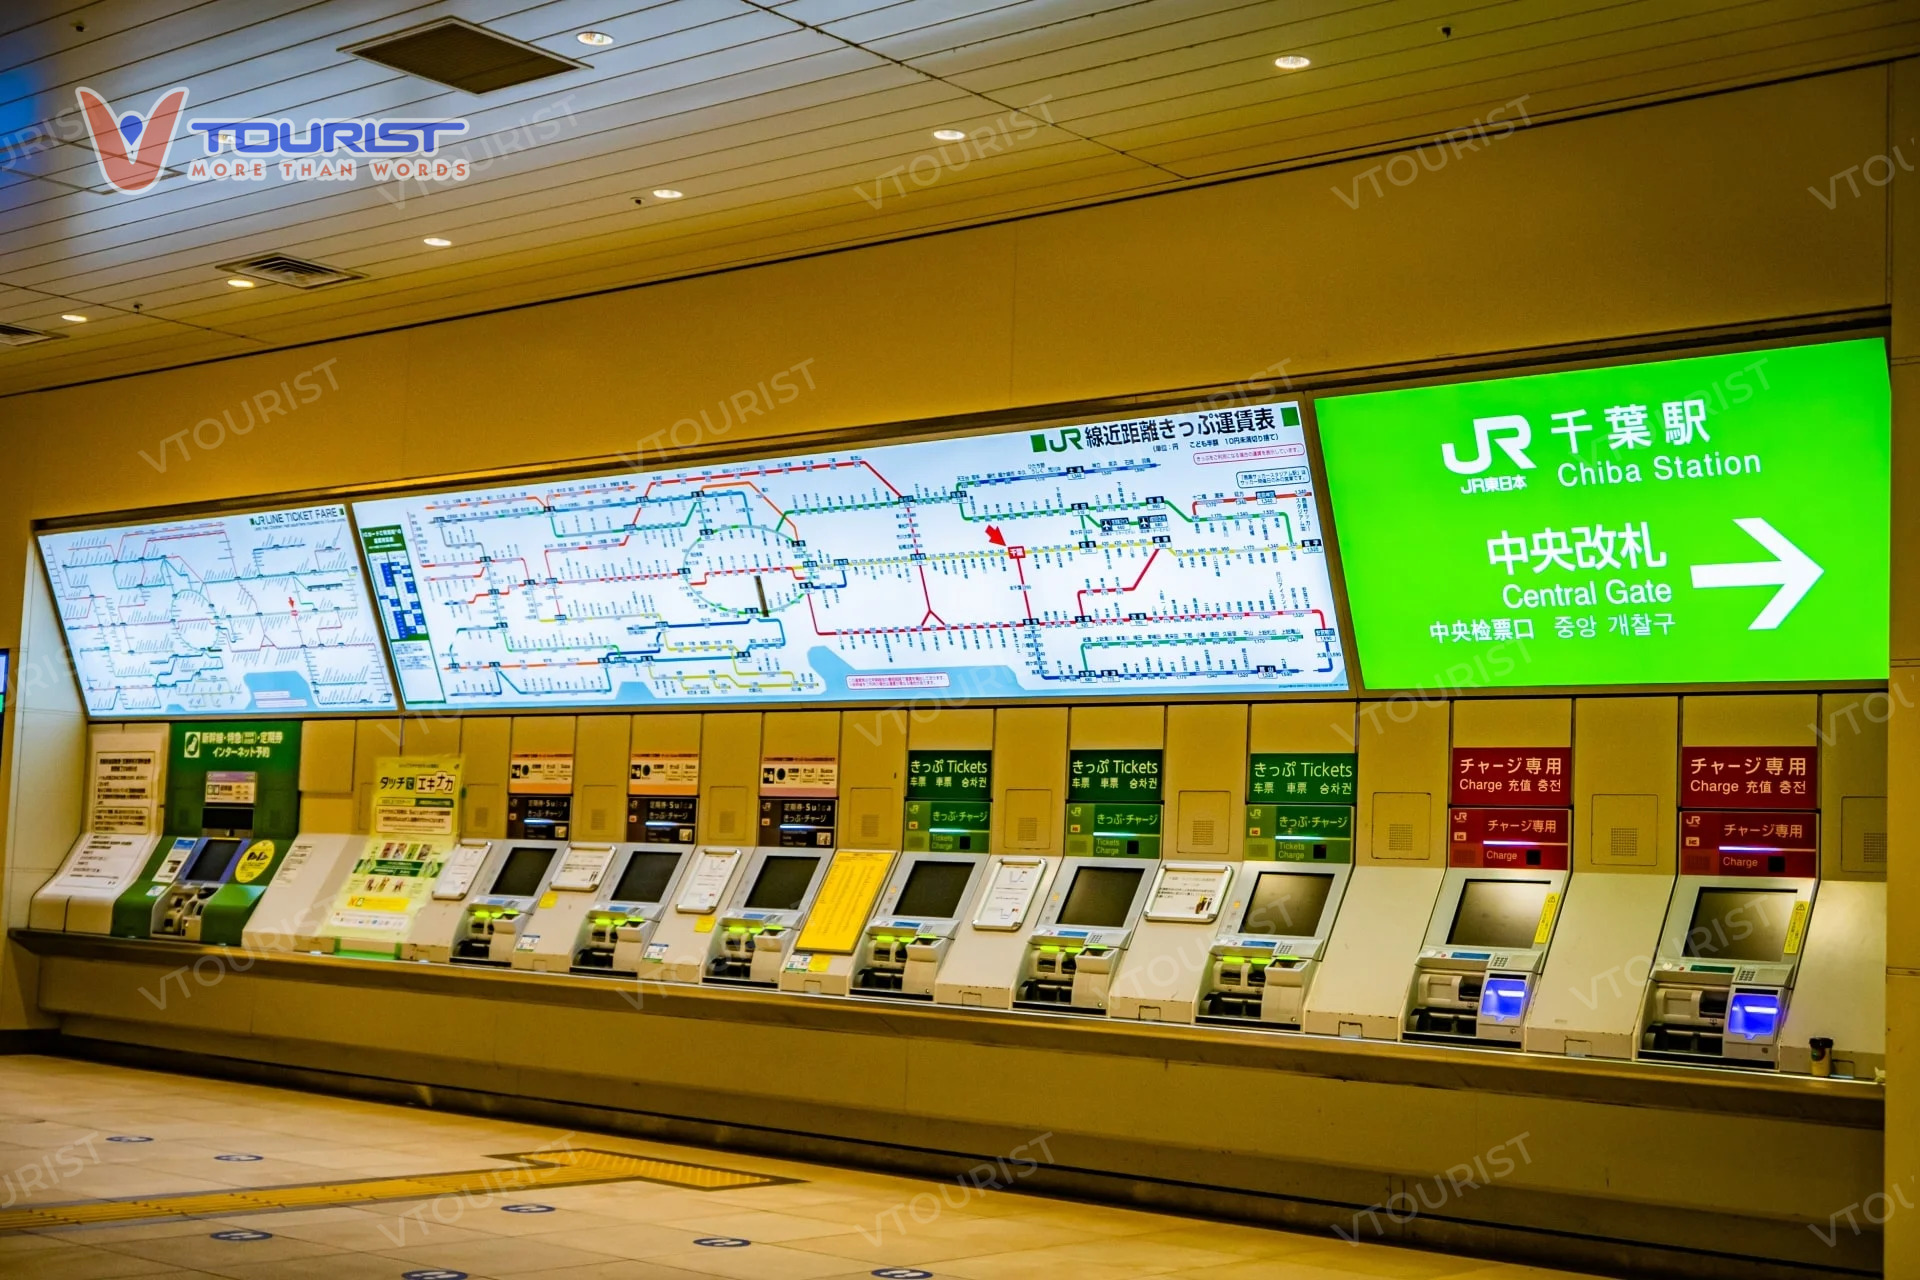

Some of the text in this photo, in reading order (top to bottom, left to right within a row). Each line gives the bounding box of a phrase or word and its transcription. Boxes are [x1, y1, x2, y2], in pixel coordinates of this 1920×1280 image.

[1550, 399, 1710, 454] 千葉駅
[1441, 414, 1537, 475] JR
[1557, 452, 1762, 487] Chiba Station
[1460, 475, 1528, 494] JR東日本
[266, 514, 284, 524] LINE
[285, 510, 313, 522] TICKET
[316, 507, 338, 519] FARE
[1486, 521, 1667, 576] 中央改札
[1502, 578, 1672, 609] Central Gate
[1429, 618, 1534, 644] 中央检票口
[1553, 613, 1676, 638] 중앙 개찰구
[911, 758, 988, 774] きっぷ Tickets
[1072, 758, 1158, 774] きっぷ Tickets
[1254, 761, 1353, 777] きっぷ Tickets
[1460, 757, 1562, 775] チャージ専用
[1690, 757, 1806, 776] チャージ専用
[1129, 777, 1157, 789] 승차권
[1319, 782, 1352, 795] 승차권
[1460, 778, 1561, 793] Charge 充值 충전
[1690, 779, 1806, 795] Charge 充值 충전
[1454, 811, 1467, 821] JR
[1686, 815, 1701, 825] JR
[1488, 819, 1557, 833] チャージ専用
[1724, 823, 1803, 839] チャージ専用
[1096, 838, 1120, 846] Tickets
[1279, 842, 1305, 850] Tickets
[1096, 846, 1119, 856] Charge
[1278, 851, 1305, 860] Charge
[1486, 850, 1518, 863] Charge
[1723, 857, 1758, 868] Charge
